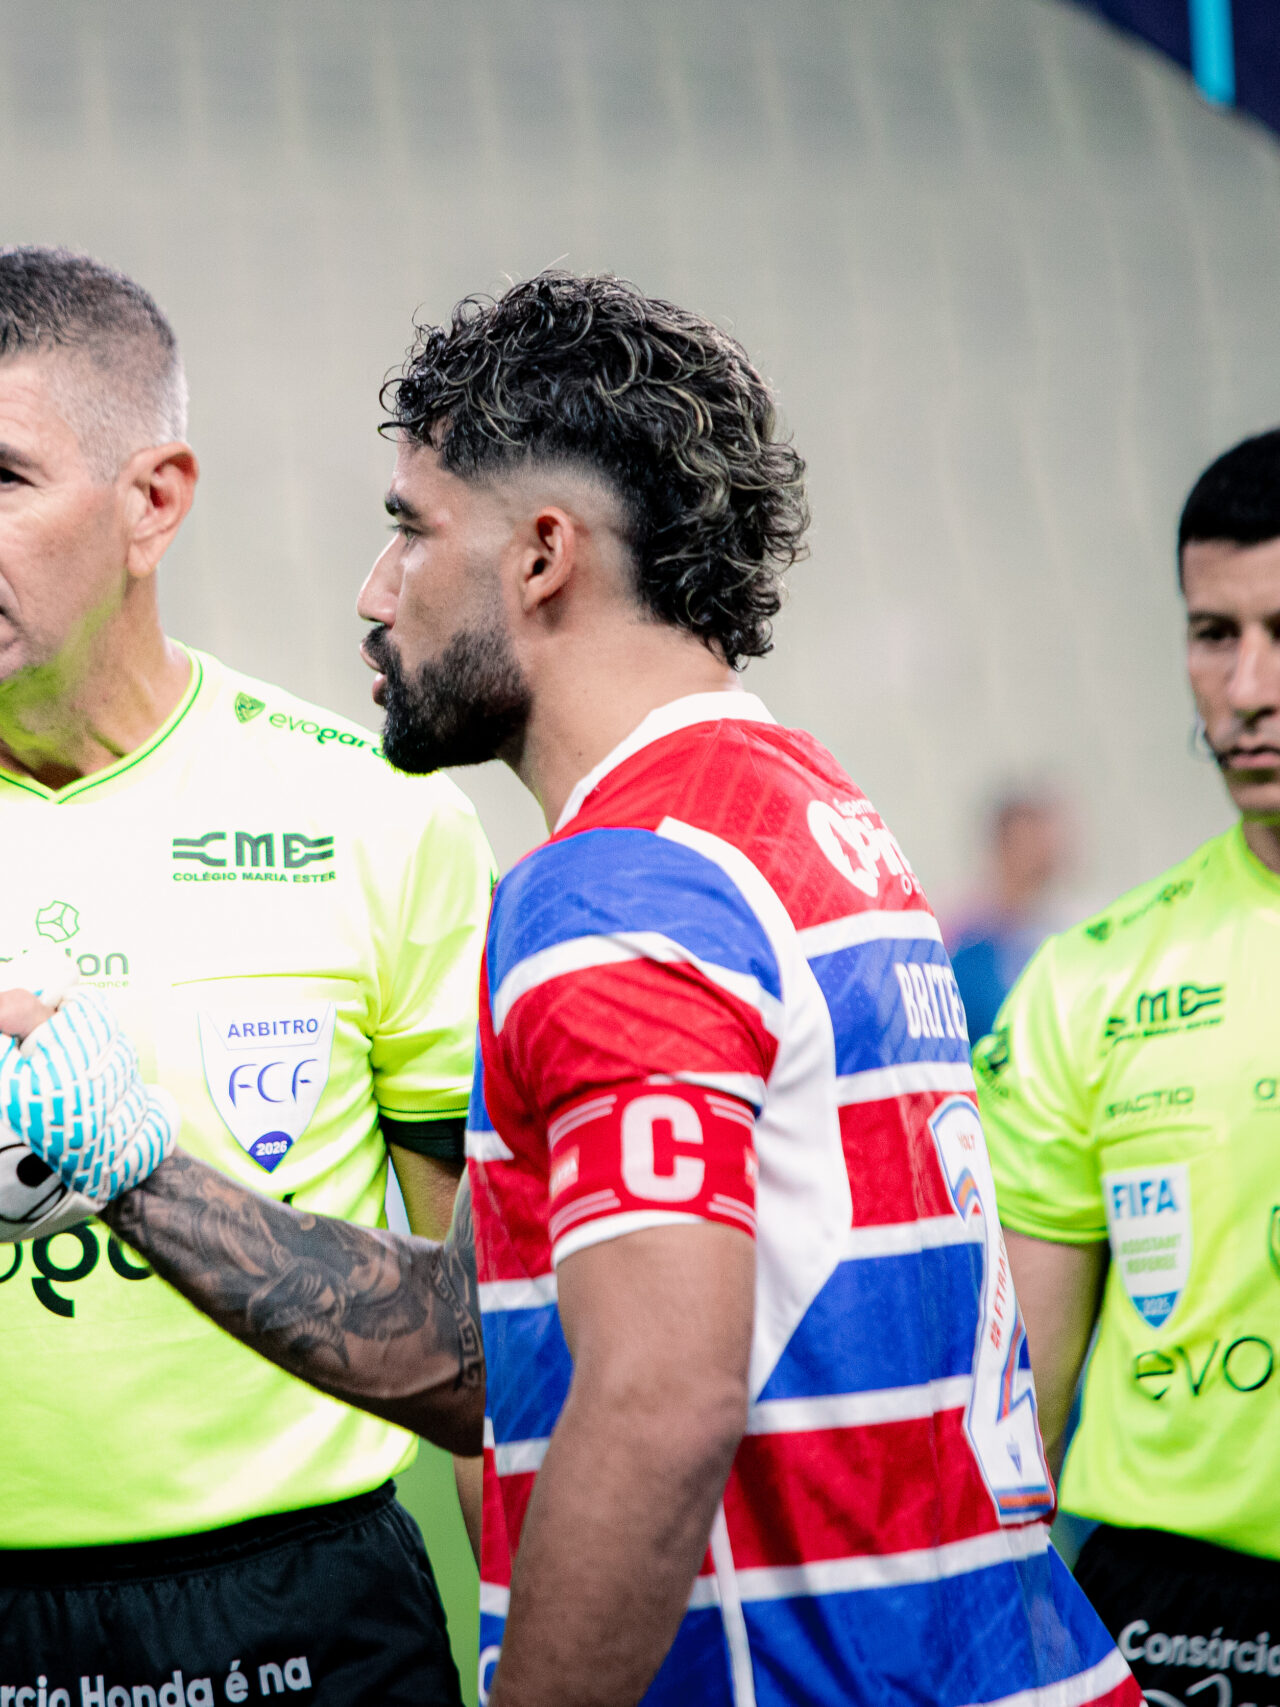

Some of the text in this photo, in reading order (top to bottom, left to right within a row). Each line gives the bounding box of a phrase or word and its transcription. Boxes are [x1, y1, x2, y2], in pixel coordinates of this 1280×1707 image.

[173, 831, 334, 868] CME
[242, 872, 288, 883] MARIA
[292, 871, 337, 884] ESTER
[227, 1018, 319, 1039] ARBITRO
[228, 1058, 319, 1110] FCF
[255, 1141, 288, 1157] 2026
[621, 1094, 706, 1204] C
[1112, 1179, 1180, 1220] FIFA
[80, 1670, 215, 1707] Honda
[224, 1659, 249, 1703] é
[258, 1656, 312, 1696] na
